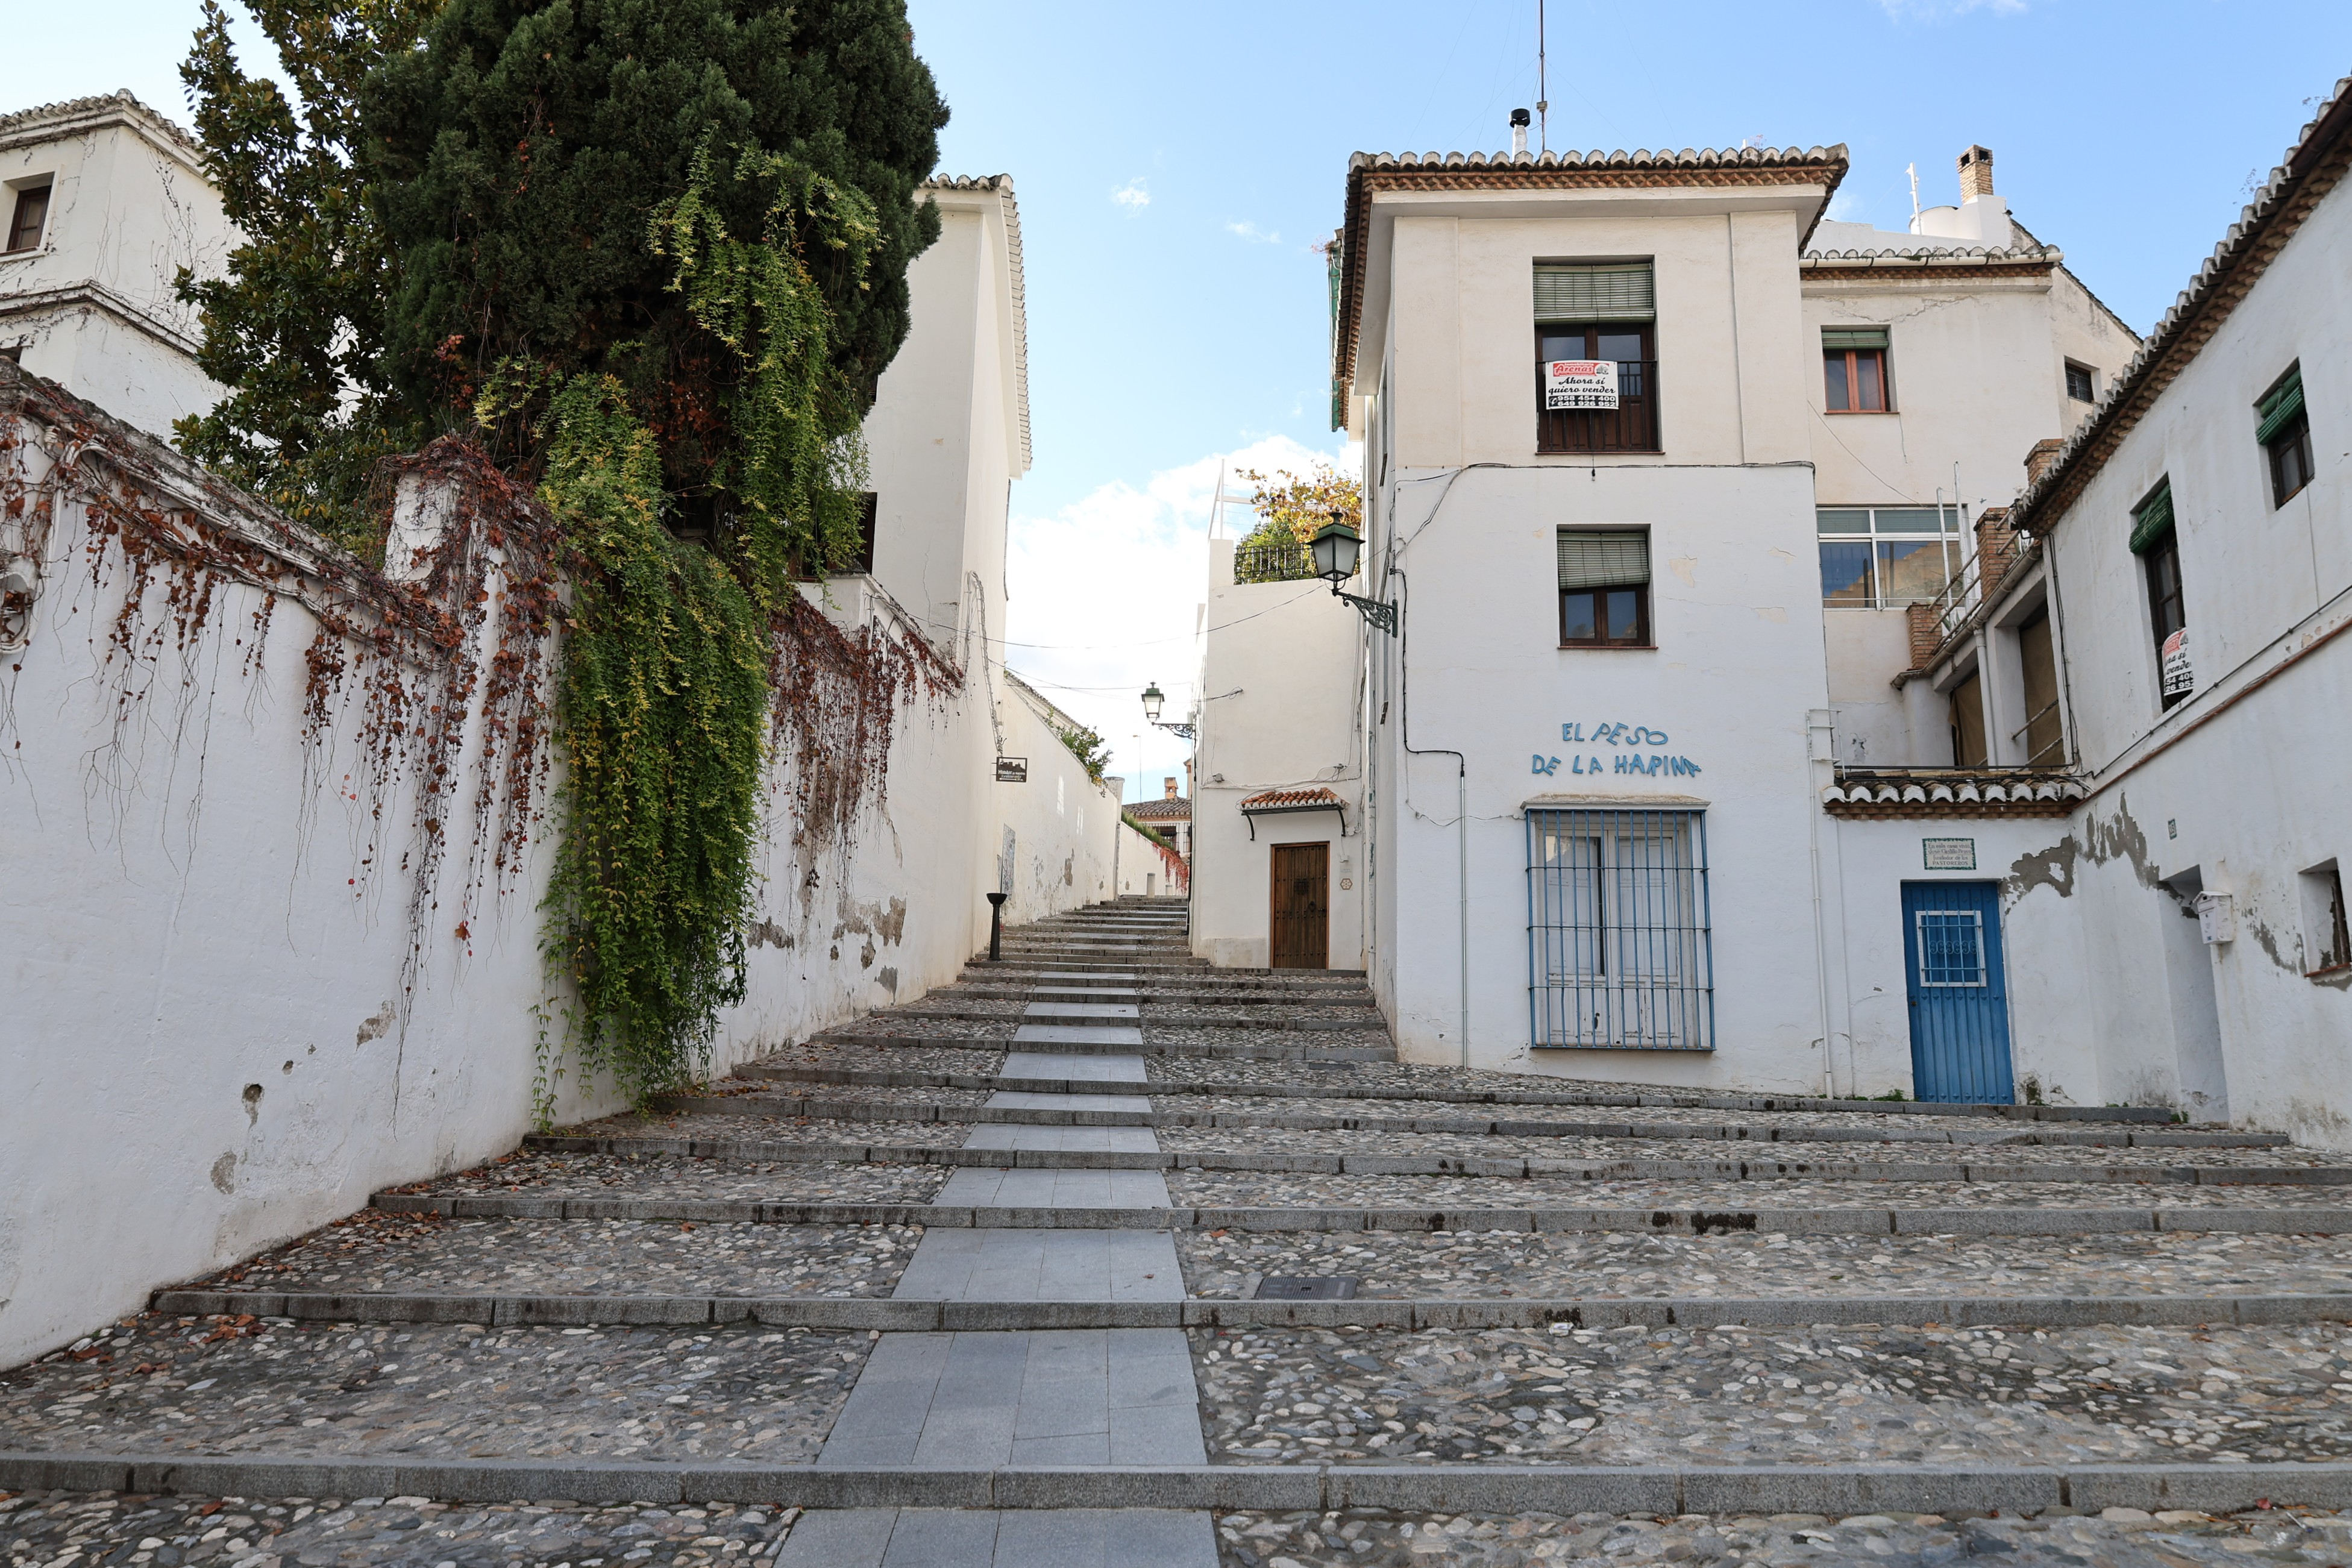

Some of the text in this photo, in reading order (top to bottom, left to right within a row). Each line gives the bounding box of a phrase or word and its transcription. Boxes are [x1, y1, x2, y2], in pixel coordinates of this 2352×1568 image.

[1555, 365, 1593, 374] Arenas
[1548, 386, 1580, 395] quiero
[1562, 721, 1669, 745] EL PESO
[1532, 754, 1561, 776] DE
[1572, 754, 1604, 774] LA
